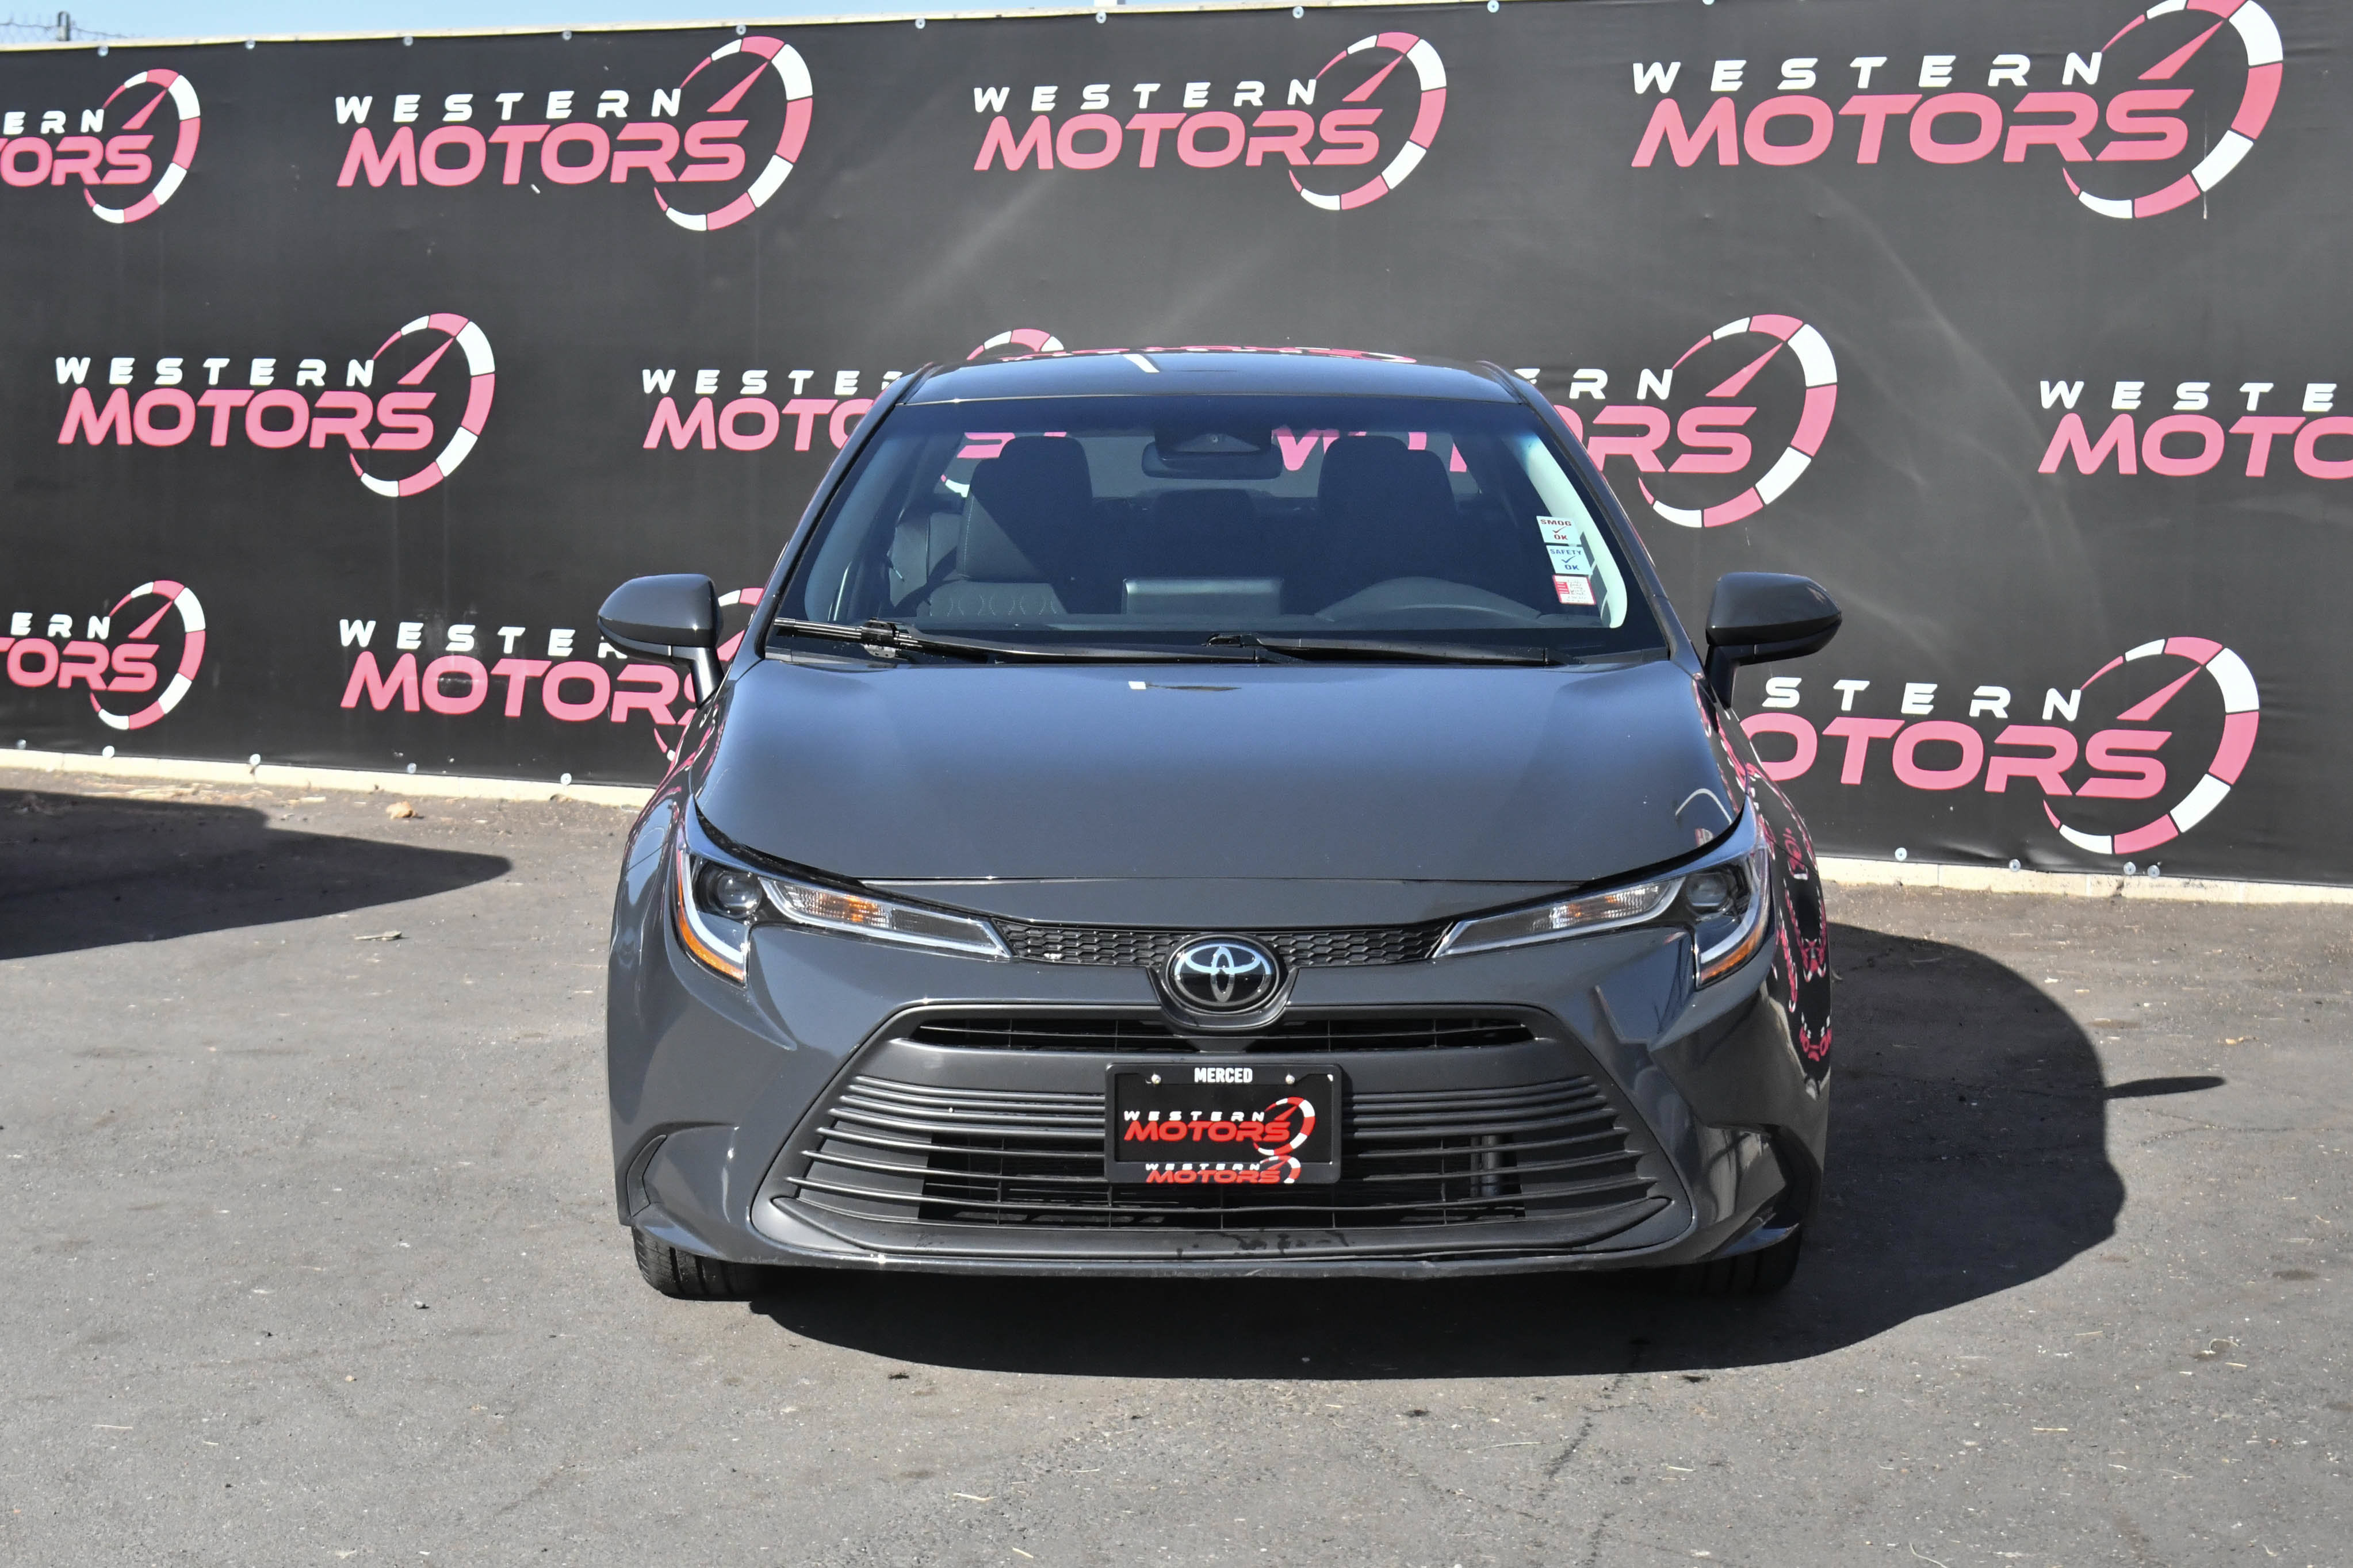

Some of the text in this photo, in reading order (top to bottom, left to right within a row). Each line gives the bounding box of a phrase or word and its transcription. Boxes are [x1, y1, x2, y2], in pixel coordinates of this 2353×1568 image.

[1633, 52, 2102, 94] WESTERN
[335, 88, 681, 124] WESTERN
[974, 79, 1317, 113] WESTERN
[974, 108, 1383, 171] MOTORS
[1631, 89, 2194, 168] MOTORS
[0, 135, 154, 187] ORS
[336, 119, 749, 187] MOTORS
[56, 356, 374, 387] WESTERN
[2040, 380, 2337, 412] WESTE
[58, 386, 437, 451] MOTORS
[2038, 412, 2353, 480] MOTO
[1540, 519, 1572, 527] SMOG
[0, 637, 159, 692] ORS
[340, 651, 697, 726] MOTOR
[1194, 1067, 1253, 1083] MERCED
[1124, 1110, 1265, 1122] WESTERN
[1124, 1121, 1291, 1142] MOTORS
[1146, 1163, 1260, 1171] WESTERN
[1146, 1170, 1281, 1184] MOTORS
